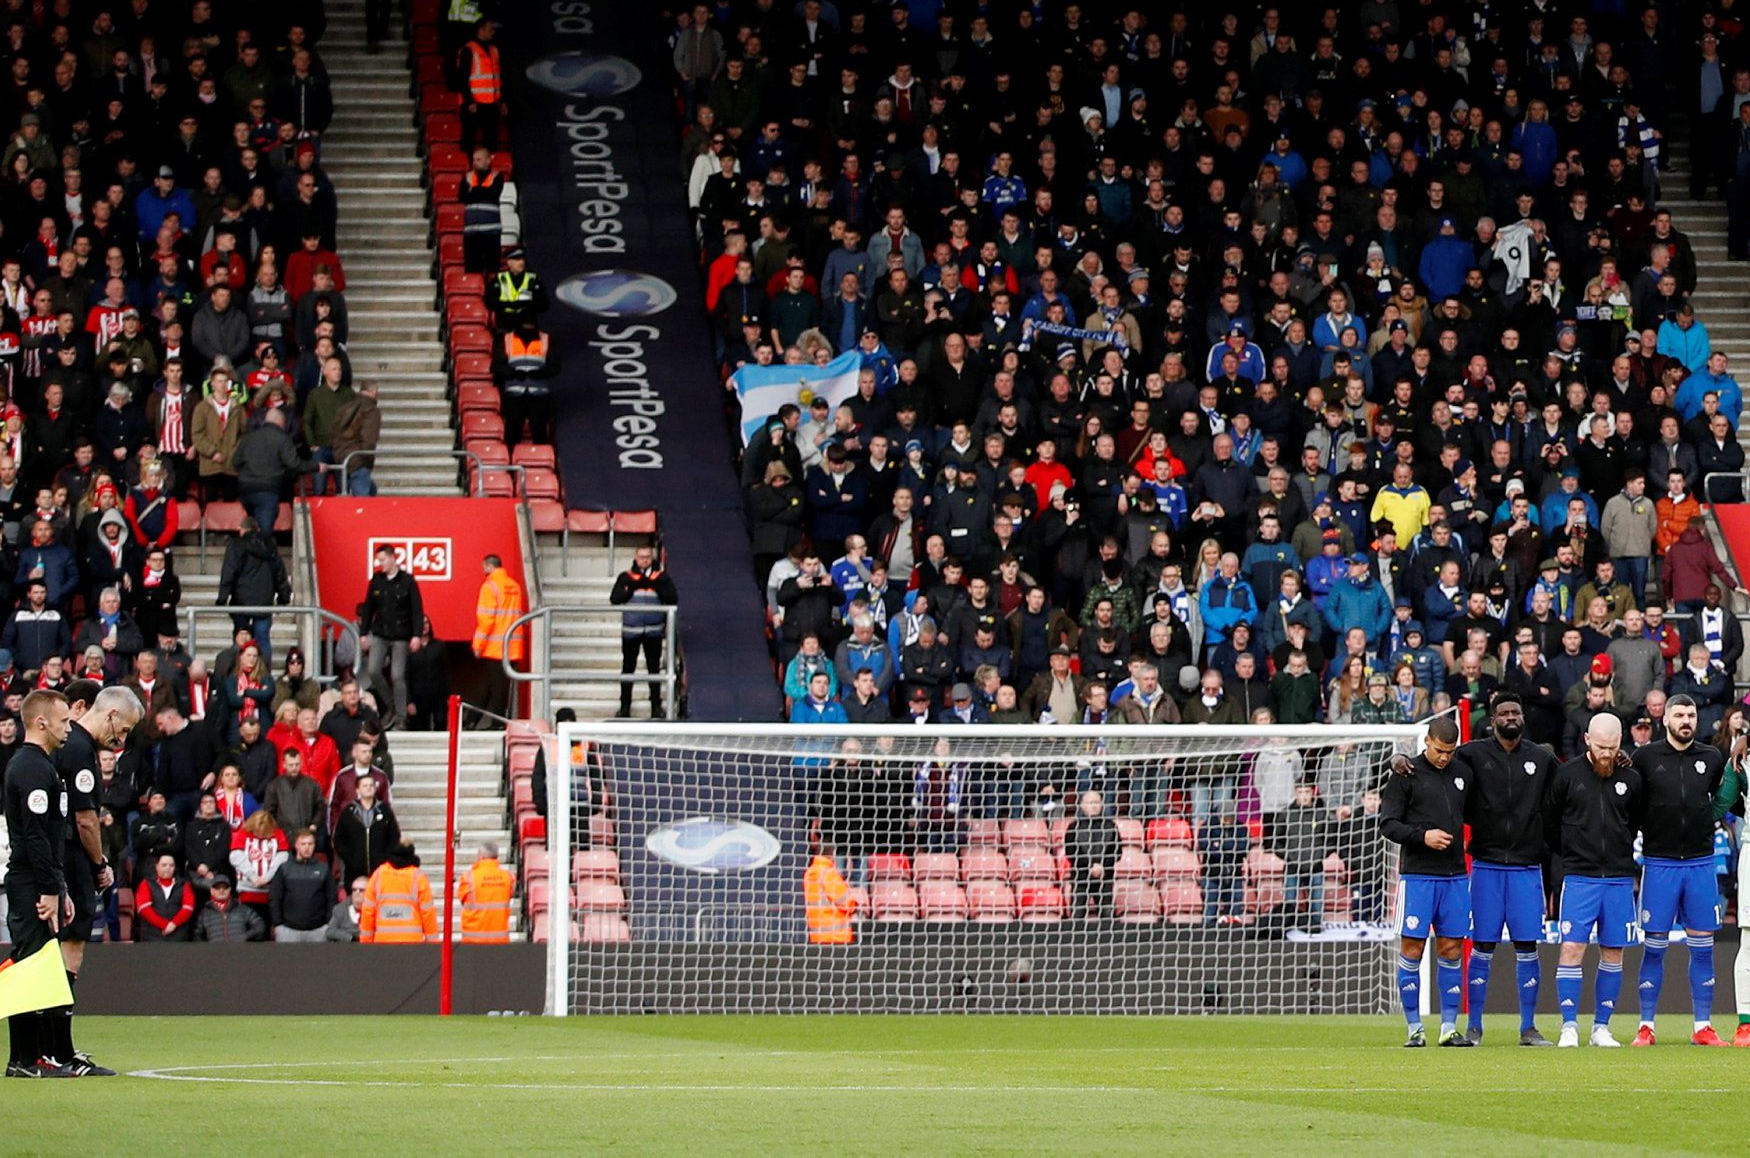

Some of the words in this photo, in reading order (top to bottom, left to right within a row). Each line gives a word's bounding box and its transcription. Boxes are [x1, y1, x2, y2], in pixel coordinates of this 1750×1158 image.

[557, 104, 628, 254] SportPesa
[1508, 246, 1521, 260] 9
[589, 323, 665, 470] SportPesa
[414, 547, 446, 571] 43
